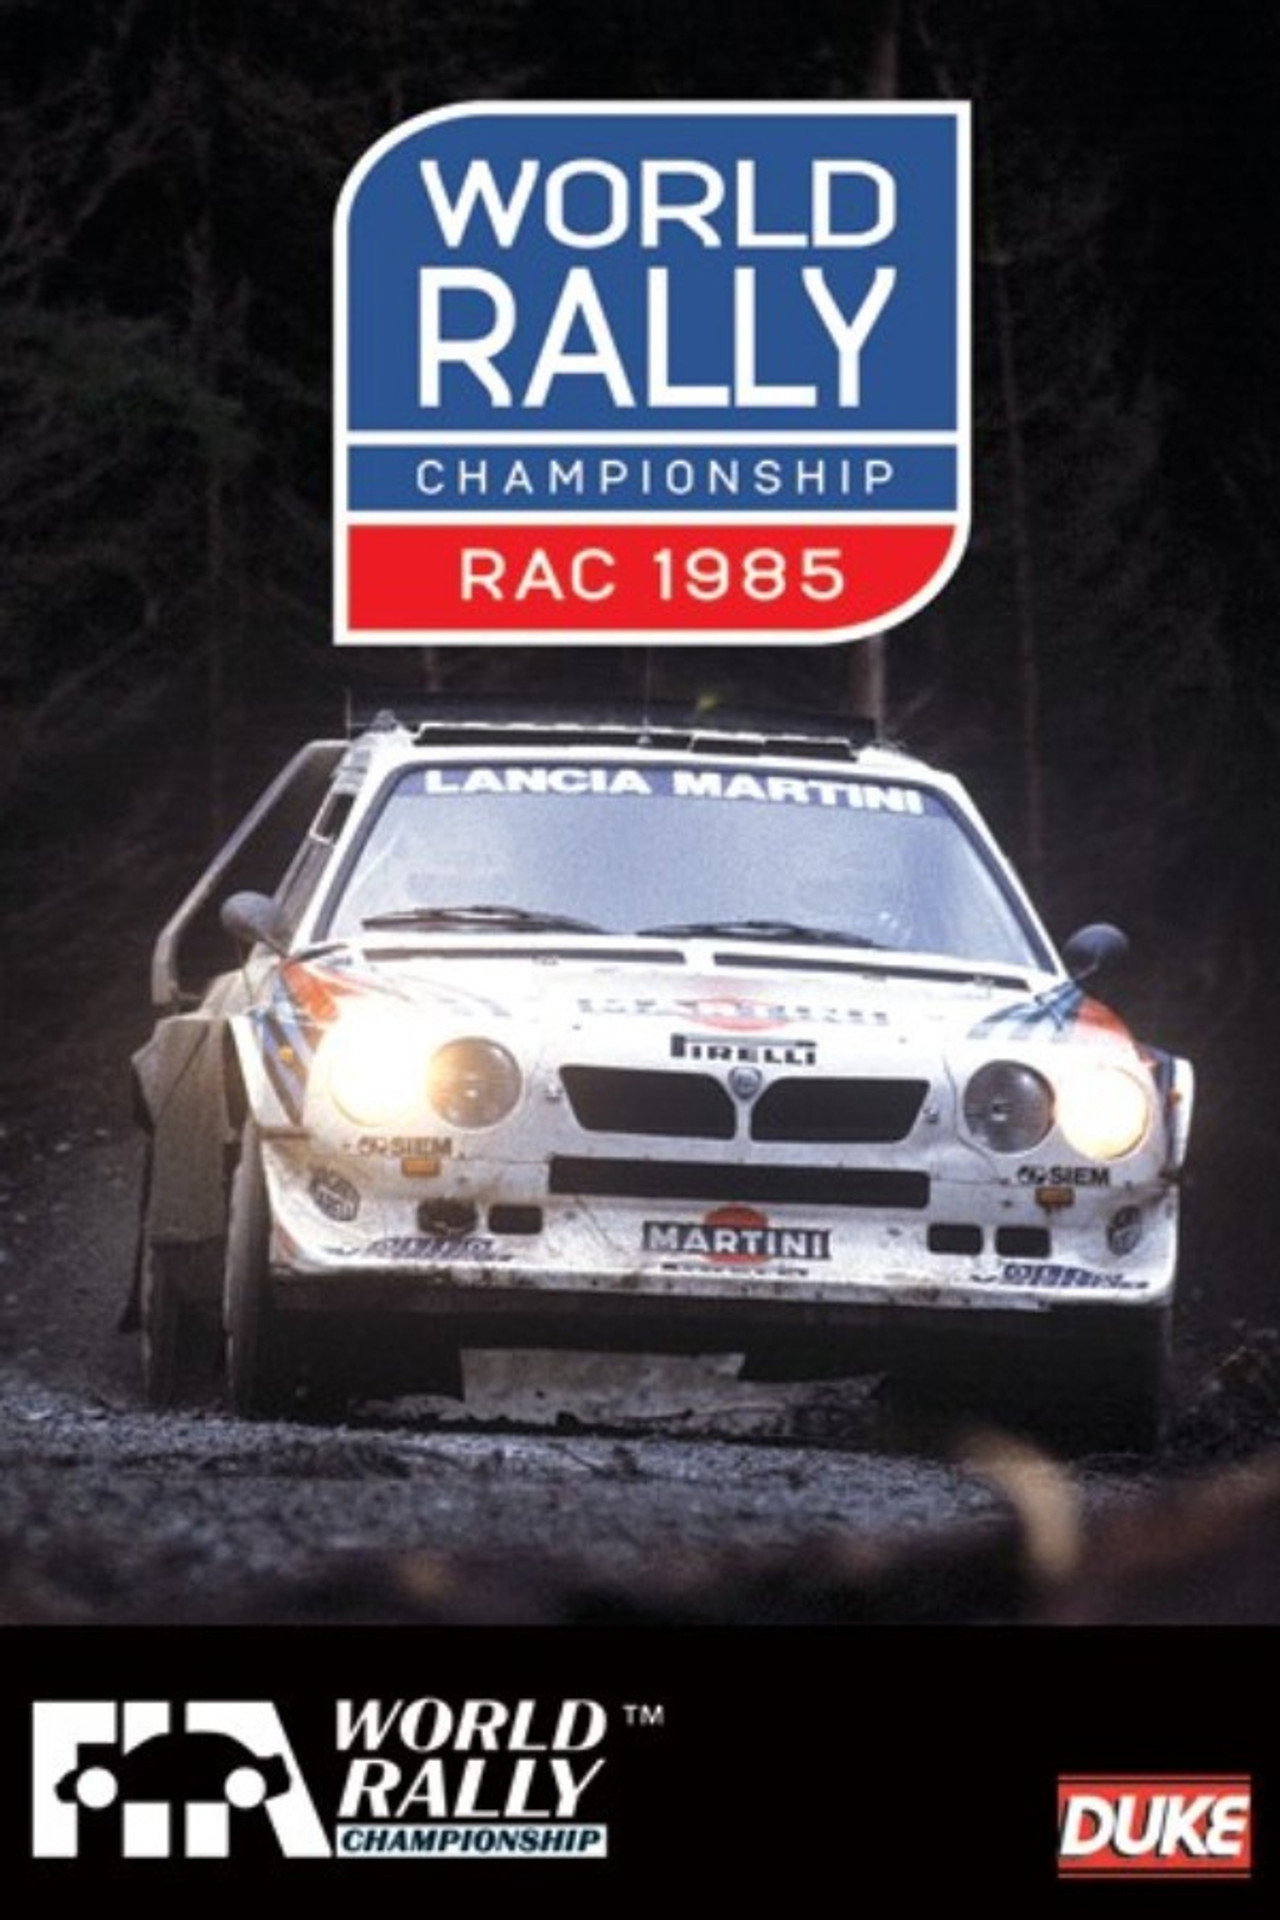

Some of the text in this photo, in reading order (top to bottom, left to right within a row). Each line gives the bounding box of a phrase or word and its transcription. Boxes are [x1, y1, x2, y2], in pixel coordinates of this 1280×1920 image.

[424, 768, 924, 815] LANCIA MARTINI
[670, 1033, 818, 1066] PIRELLI
[1049, 1165, 1111, 1187] SIEM
[649, 1223, 825, 1258] MARTINI
